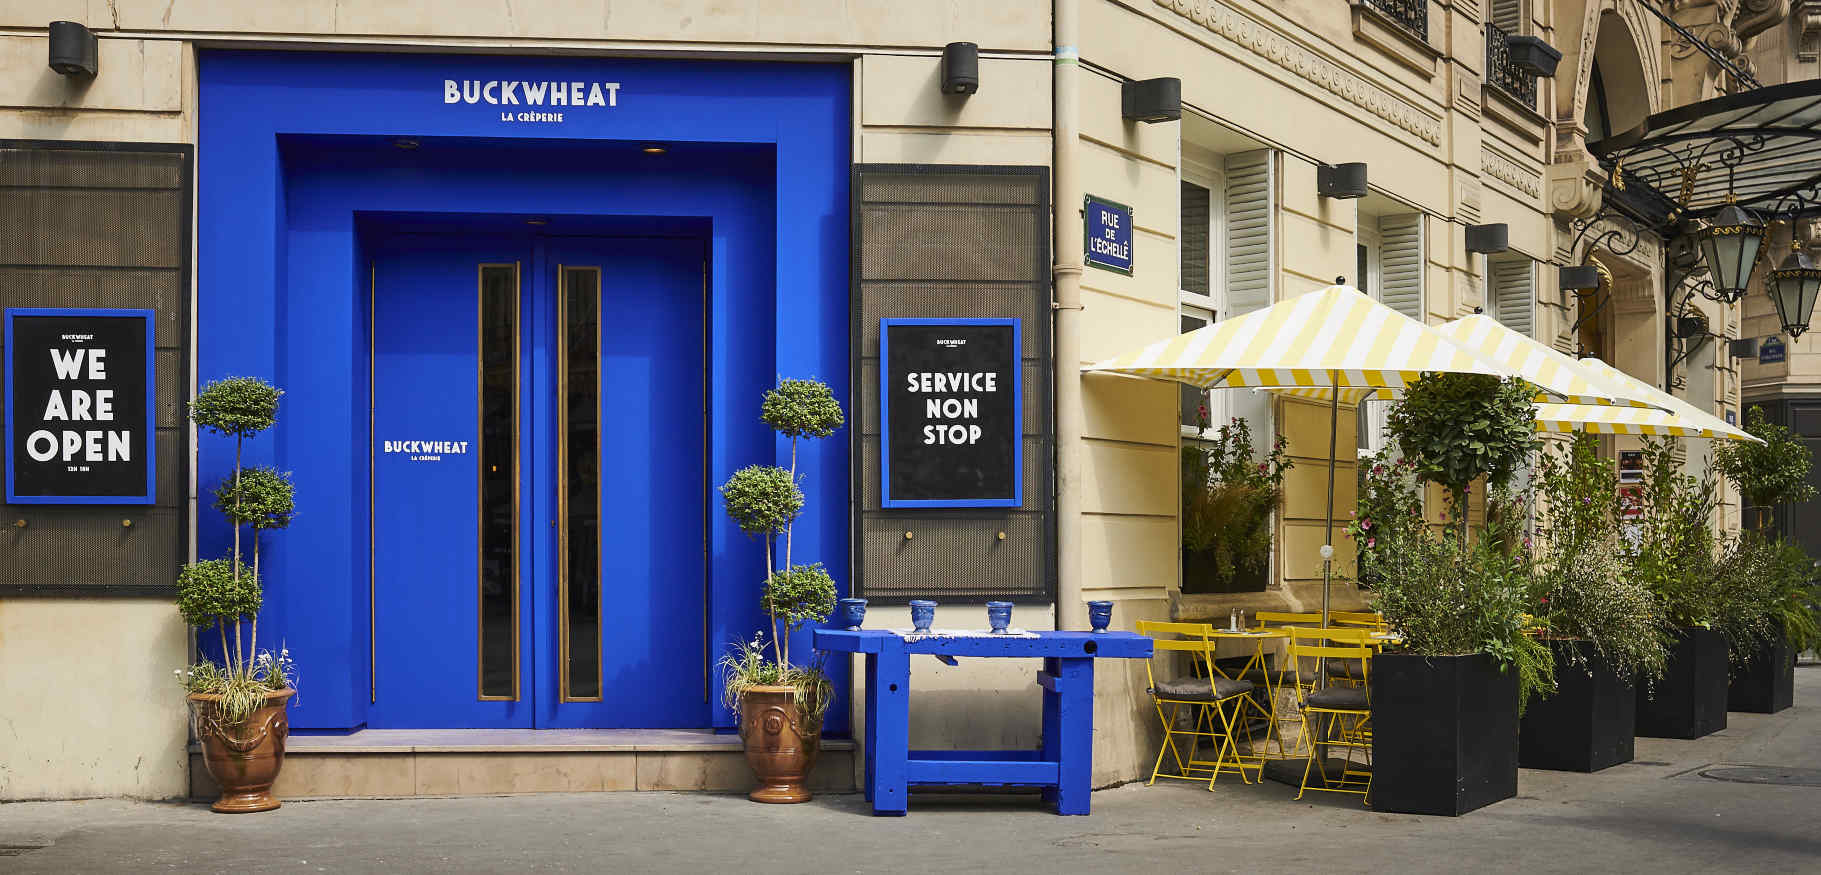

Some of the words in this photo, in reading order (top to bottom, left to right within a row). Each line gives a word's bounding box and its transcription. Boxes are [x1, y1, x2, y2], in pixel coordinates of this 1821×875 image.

[444, 79, 620, 107] BUCKWHEAT
[501, 112, 514, 122] LA
[517, 110, 563, 123] CRÊPERIE
[1101, 210, 1119, 228] RUE
[1105, 228, 1115, 240] DE
[50, 348, 106, 380] WE
[907, 372, 997, 393] SERVICE
[43, 389, 114, 421] ARE
[926, 398, 978, 419] NON
[923, 424, 982, 445] STOP
[26, 429, 131, 462] OPEN
[384, 440, 468, 454] BUCKWHEAT
